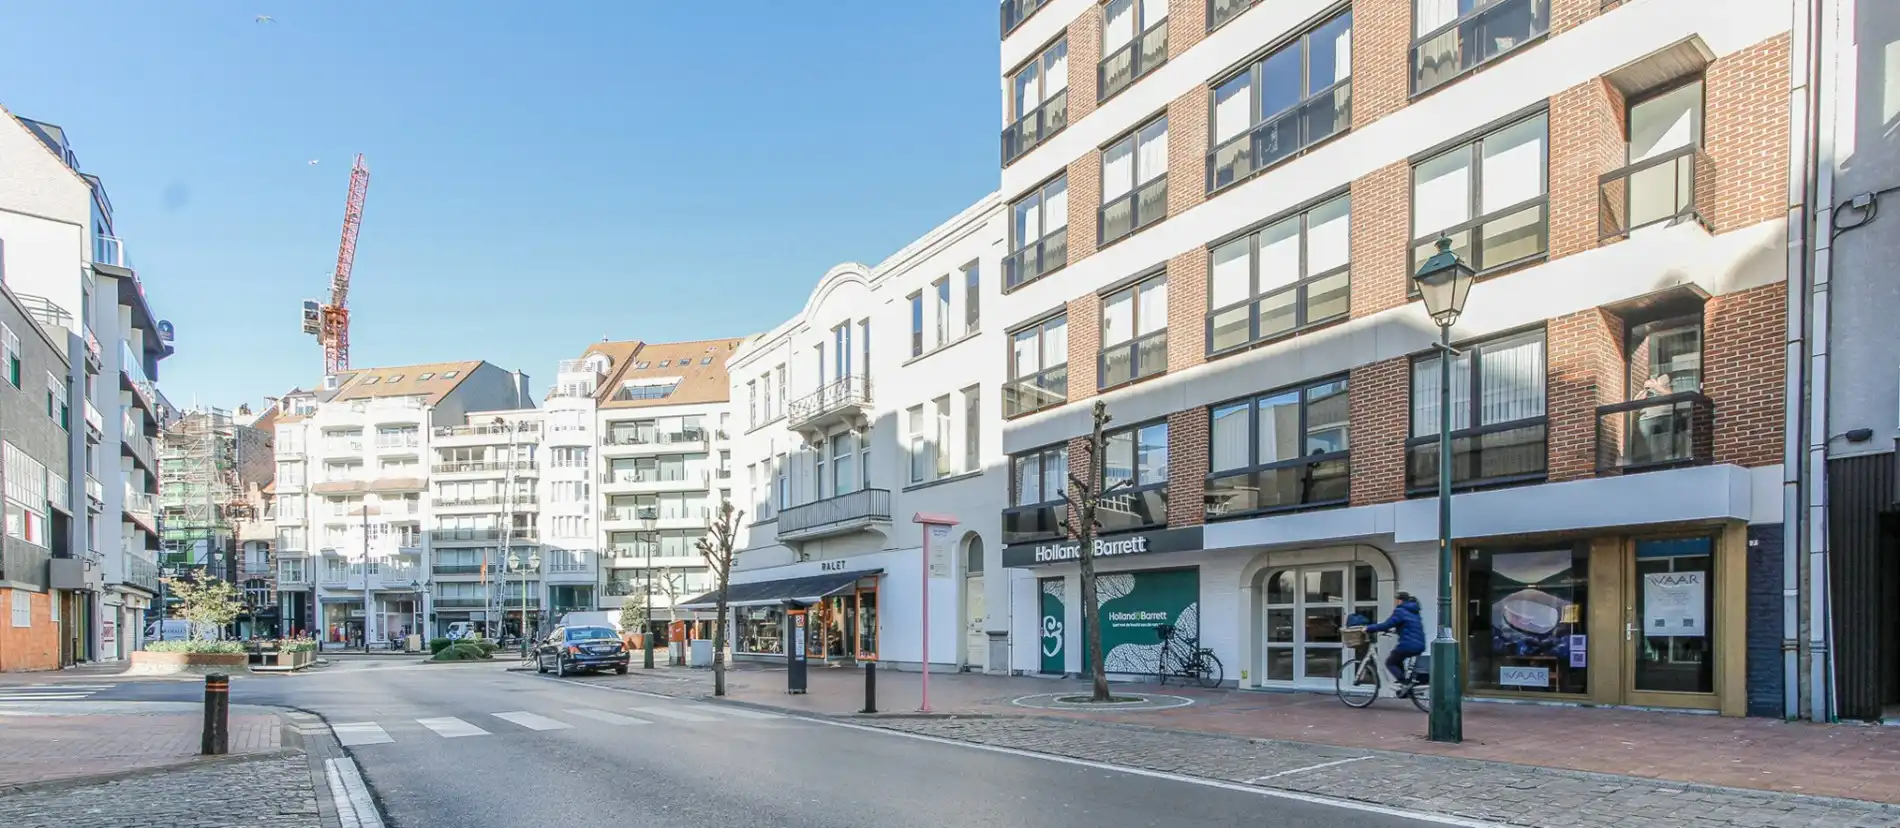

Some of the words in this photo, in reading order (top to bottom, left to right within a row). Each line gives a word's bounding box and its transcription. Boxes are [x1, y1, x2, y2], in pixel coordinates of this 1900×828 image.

[1094, 536, 1147, 557] Barrett
[1109, 611, 1136, 621] Holland
[1141, 611, 1167, 620] Barrett
